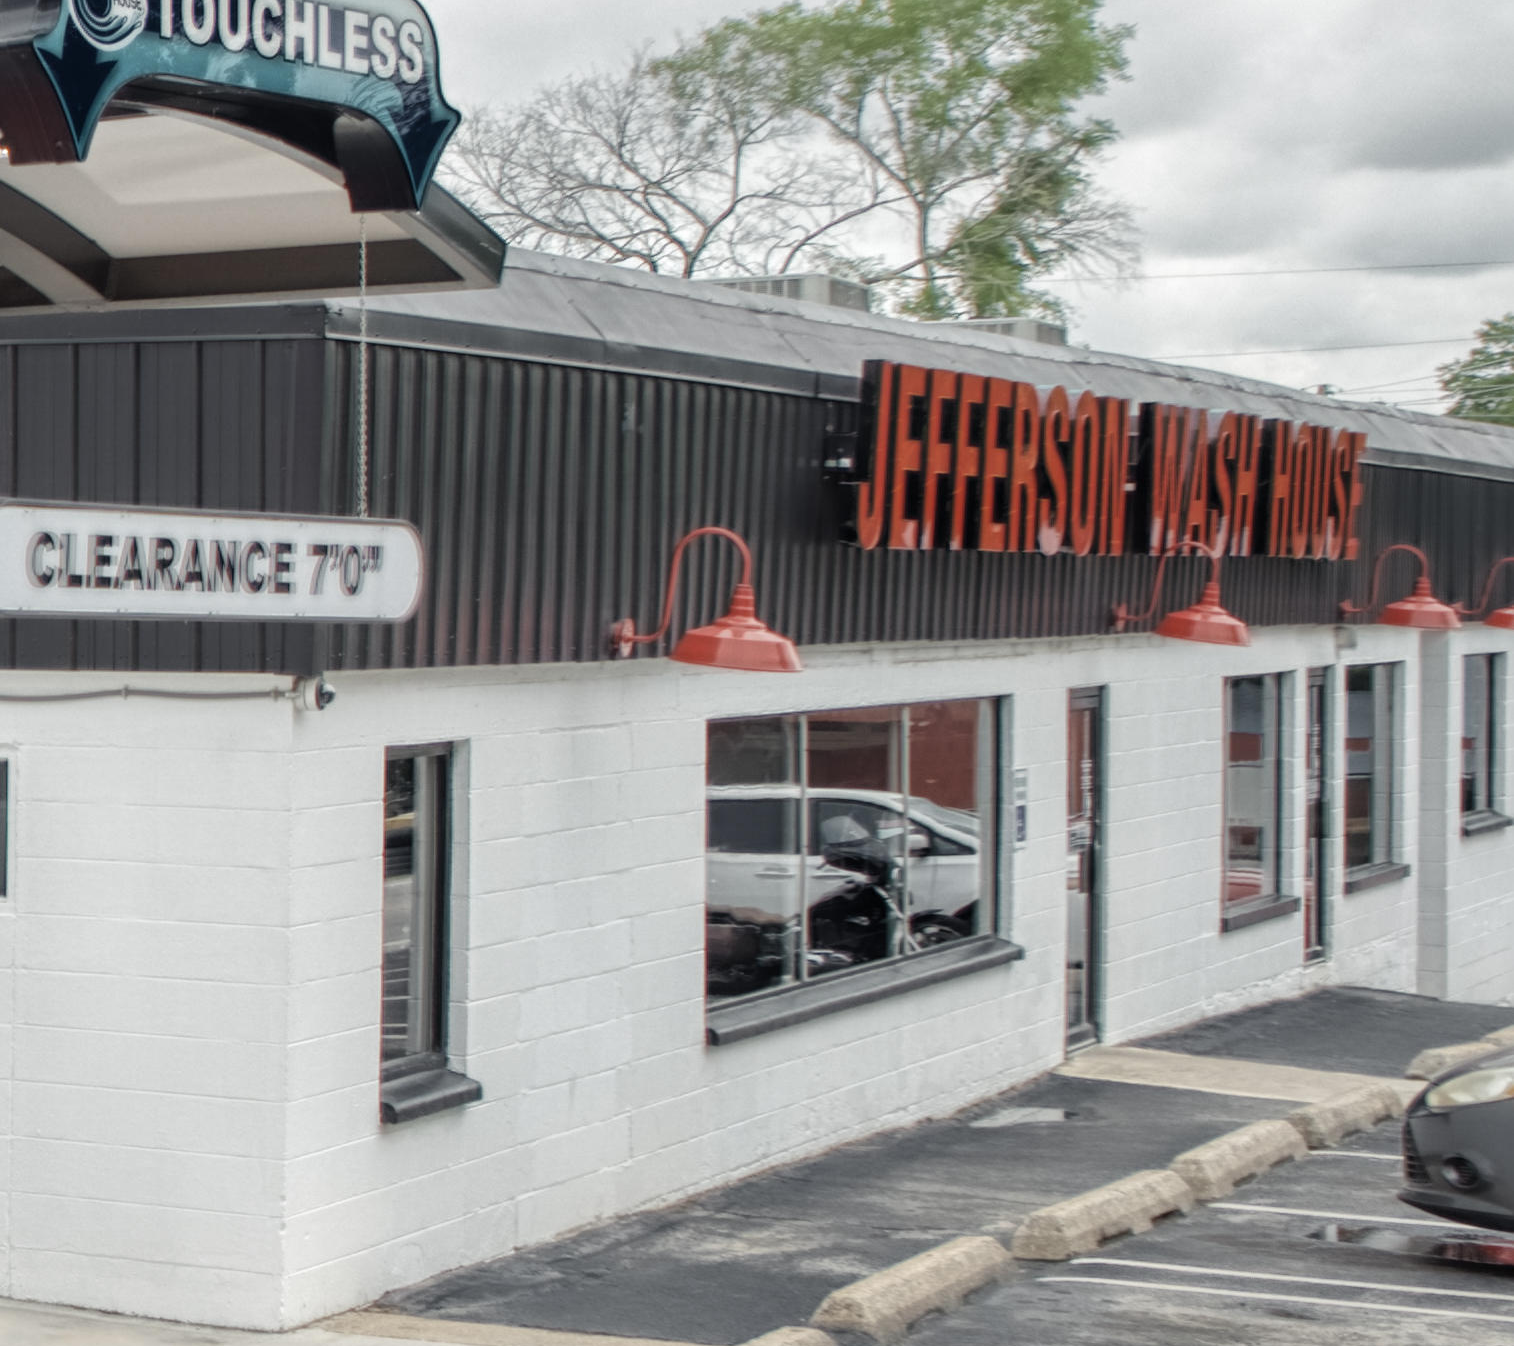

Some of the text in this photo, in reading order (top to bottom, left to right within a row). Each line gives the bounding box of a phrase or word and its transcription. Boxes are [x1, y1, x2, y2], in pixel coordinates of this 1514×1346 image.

[857, 359, 1368, 560] JEFFERSON WASH HOUSE
[25, 531, 297, 595] CLEARANCE
